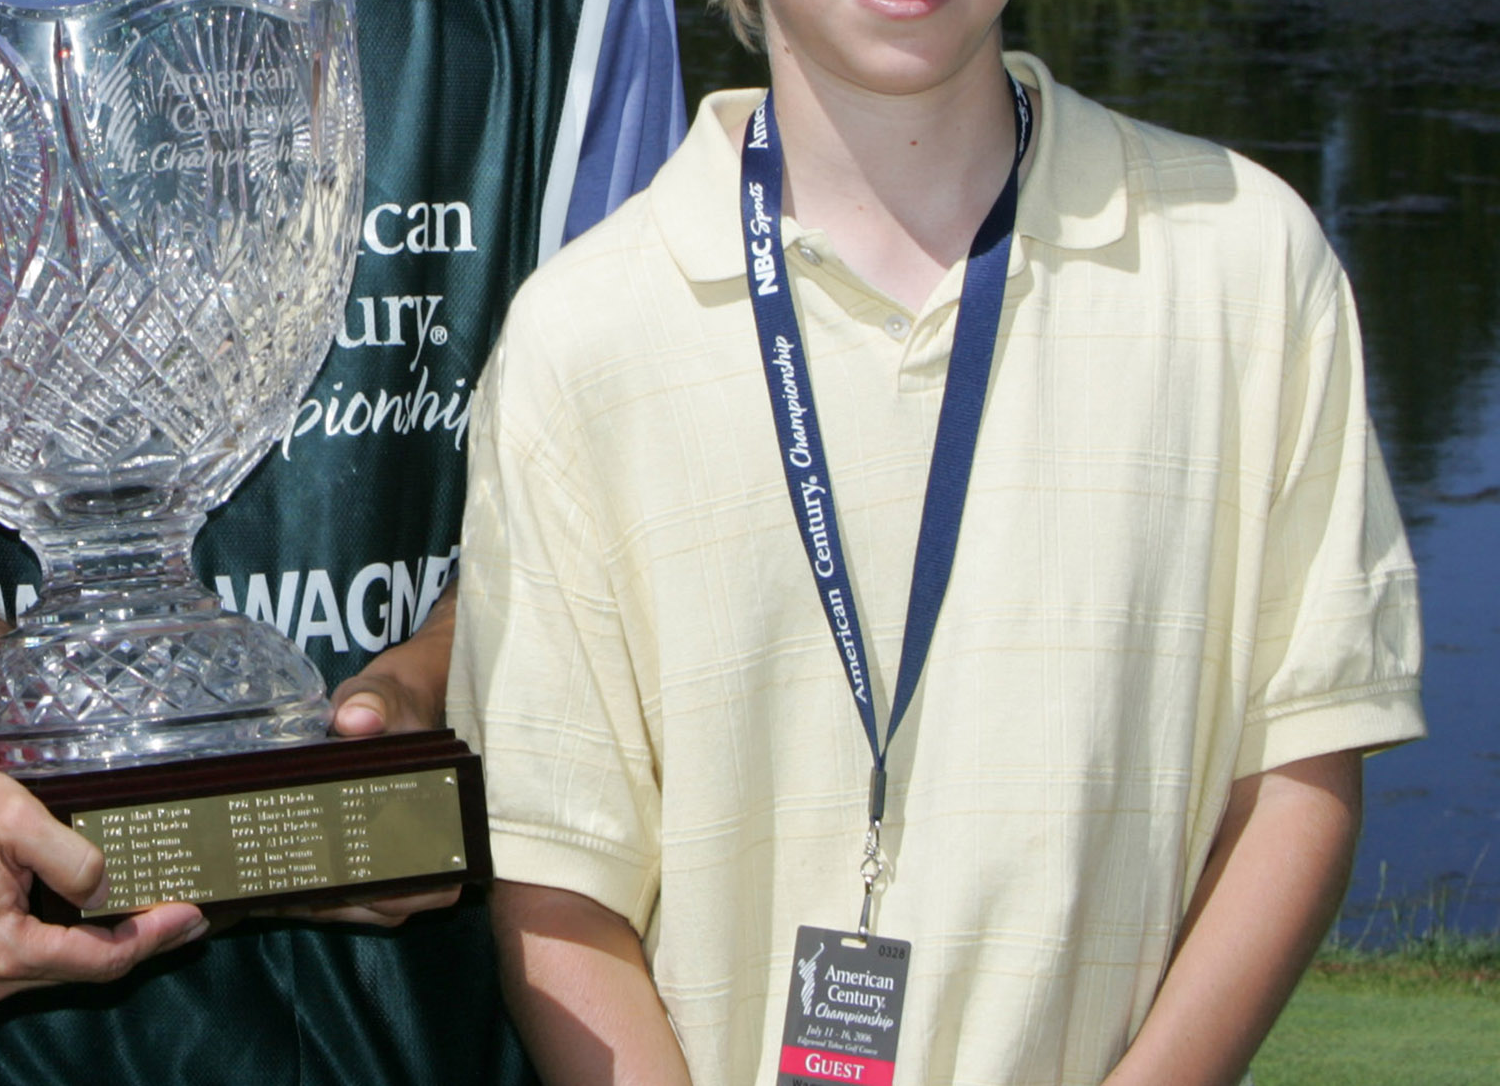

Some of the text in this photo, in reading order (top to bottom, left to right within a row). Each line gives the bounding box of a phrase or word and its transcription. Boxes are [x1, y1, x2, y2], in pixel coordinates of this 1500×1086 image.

[156, 65, 297, 98] American
[357, 201, 478, 256] can
[749, 181, 779, 296] NBC Sports
[772, 335, 812, 468] Championship
[829, 588, 868, 703] American
[824, 964, 894, 991] American
[827, 984, 886, 1013] Century
[806, 1024, 821, 1038] July
[815, 1002, 895, 1033] Championship
[805, 1053, 865, 1081] GUEST
